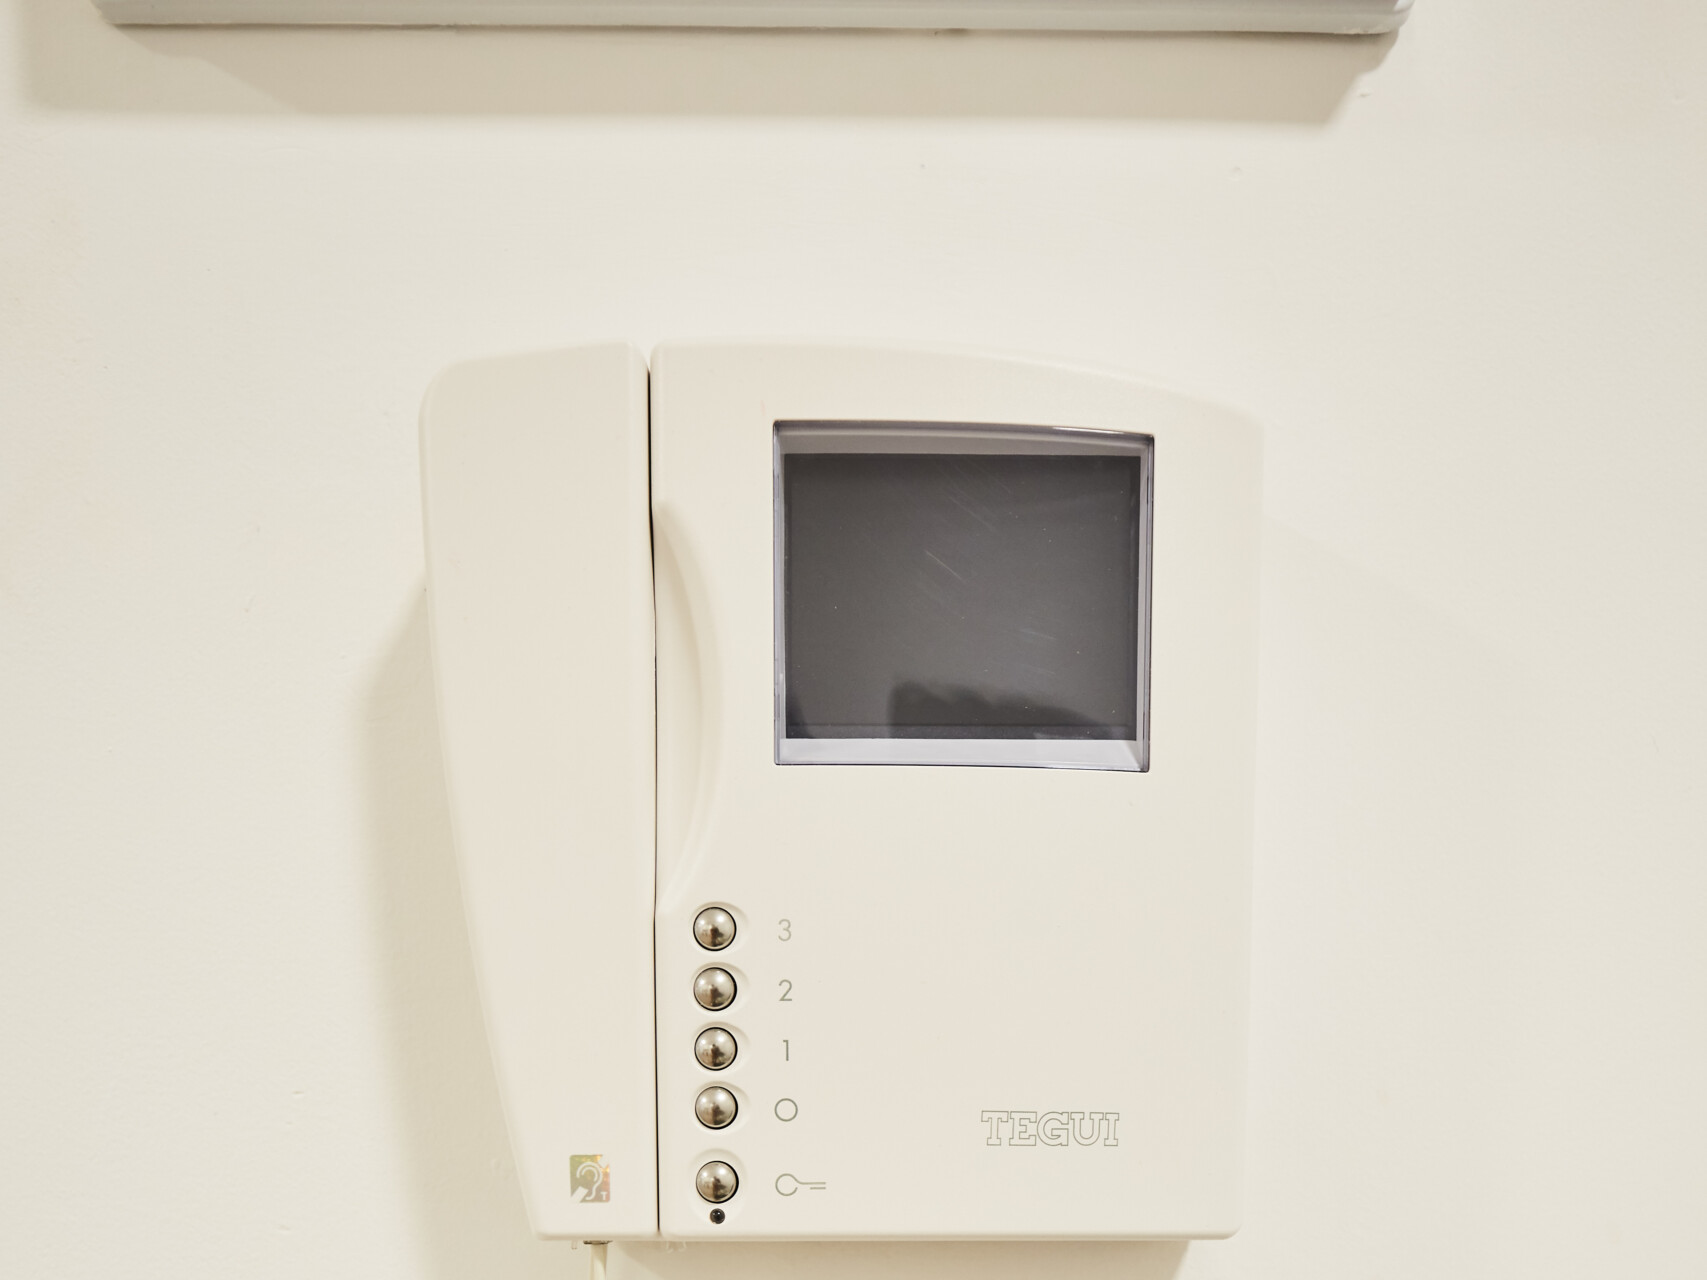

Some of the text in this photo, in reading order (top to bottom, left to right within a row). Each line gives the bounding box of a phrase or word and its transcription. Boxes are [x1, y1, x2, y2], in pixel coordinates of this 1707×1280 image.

[777, 918, 793, 942] 3
[777, 979, 793, 1002] 2
[782, 1039, 790, 1062] 1
[980, 1110, 1120, 1147] TEGUI
